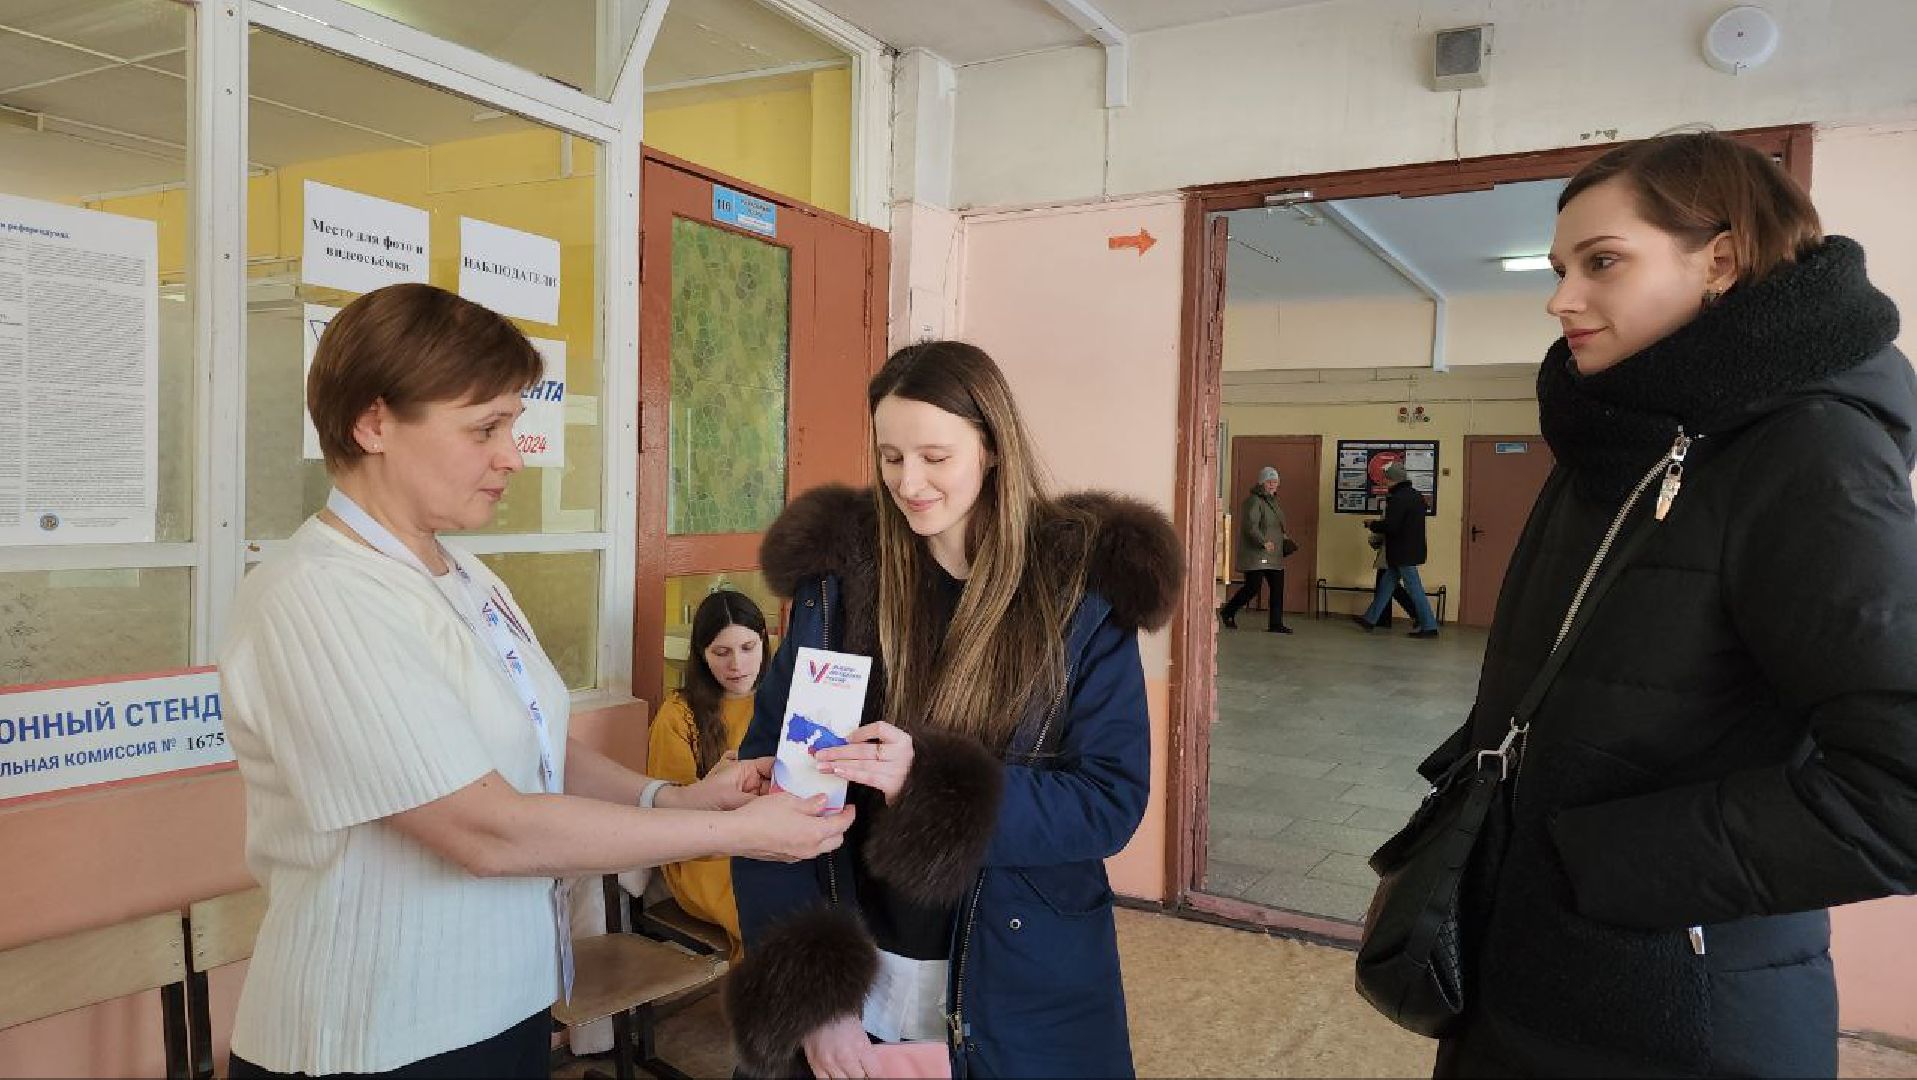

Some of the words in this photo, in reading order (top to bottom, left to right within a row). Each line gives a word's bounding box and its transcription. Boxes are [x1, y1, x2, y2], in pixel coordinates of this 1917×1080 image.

[311, 218, 354, 240] Место
[356, 232, 380, 246] для
[383, 236, 413, 251] фото
[416, 246, 424, 255] и
[464, 256, 557, 288] НАБЛЮДАТЕЛИ
[517, 434, 547, 454] 2024
[0, 701, 116, 744] ОННЫЙ
[125, 692, 222, 727] СТЕНД
[64, 740, 158, 767] КОМИССИЯ
[187, 732, 225, 751] 1675
